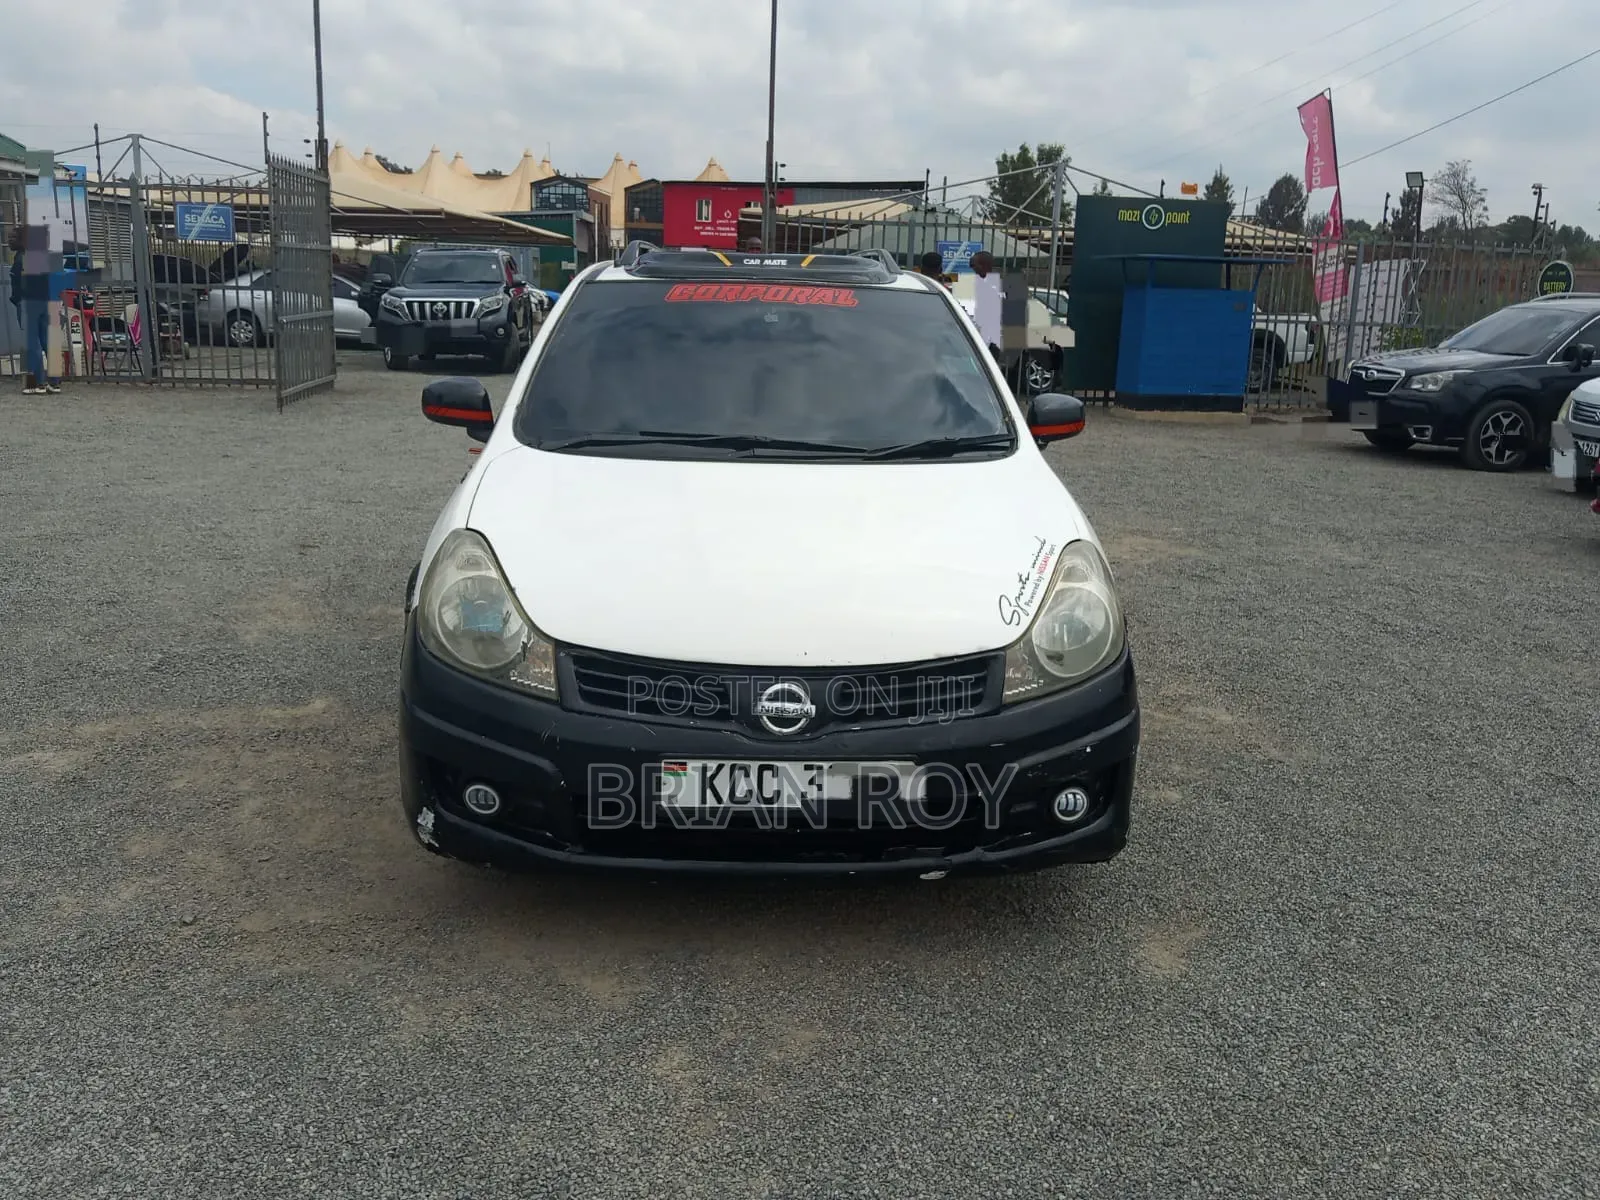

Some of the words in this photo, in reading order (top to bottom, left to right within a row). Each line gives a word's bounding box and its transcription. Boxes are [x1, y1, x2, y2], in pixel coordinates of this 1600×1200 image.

[1165, 210, 1191, 228] point
[744, 258, 760, 266] CAR
[763, 259, 788, 267] MATE
[664, 283, 859, 307] CORPORAL
[760, 704, 811, 716] NISSAN
[701, 763, 781, 806] KCC
